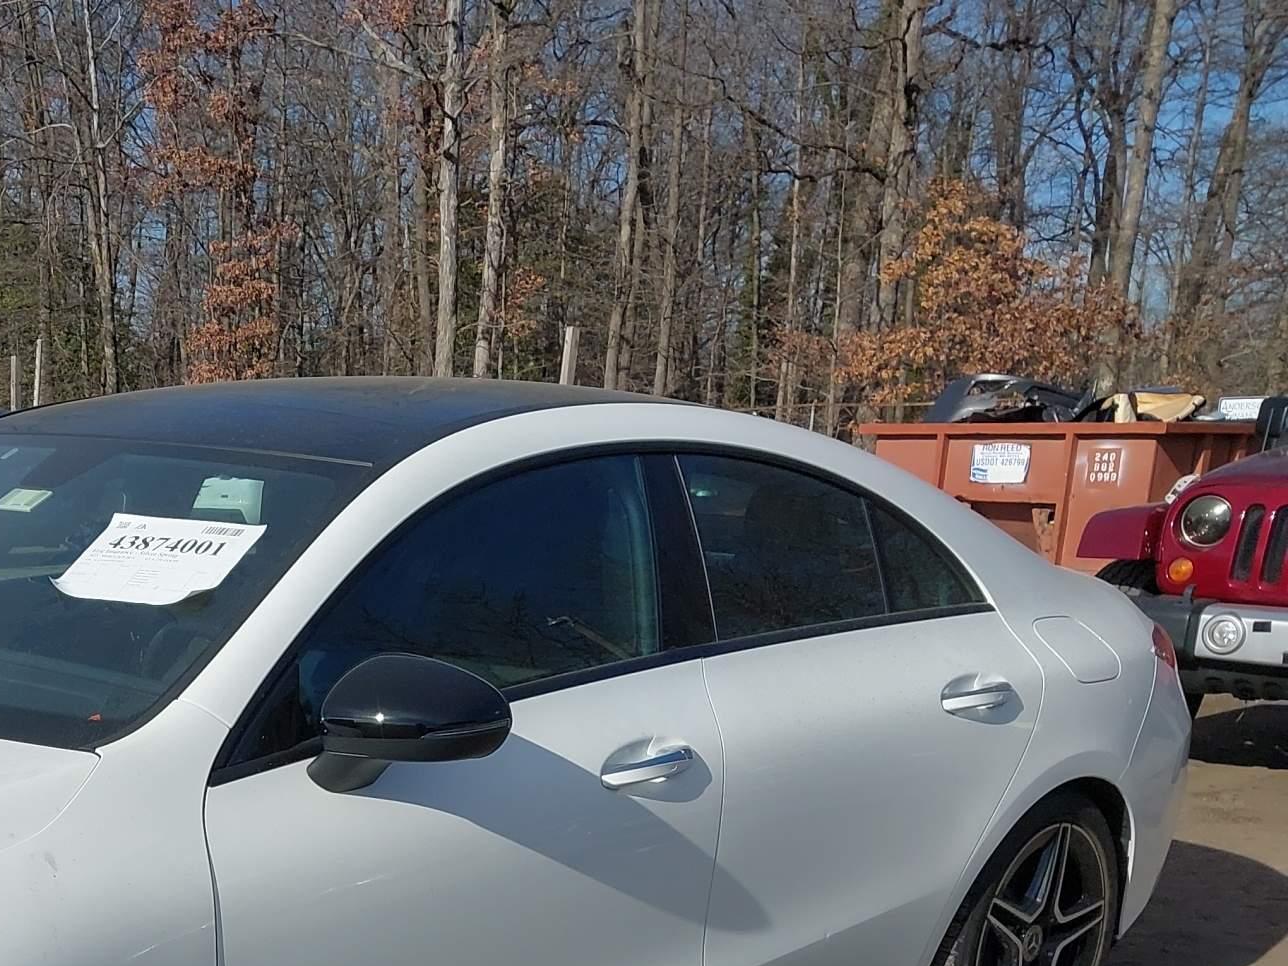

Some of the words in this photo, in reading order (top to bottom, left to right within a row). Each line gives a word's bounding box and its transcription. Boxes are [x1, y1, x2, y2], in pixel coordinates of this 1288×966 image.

[1221, 400, 1260, 411] ANDERS
[976, 458, 998, 467] USDOT
[109, 535, 227, 556] 43874001
